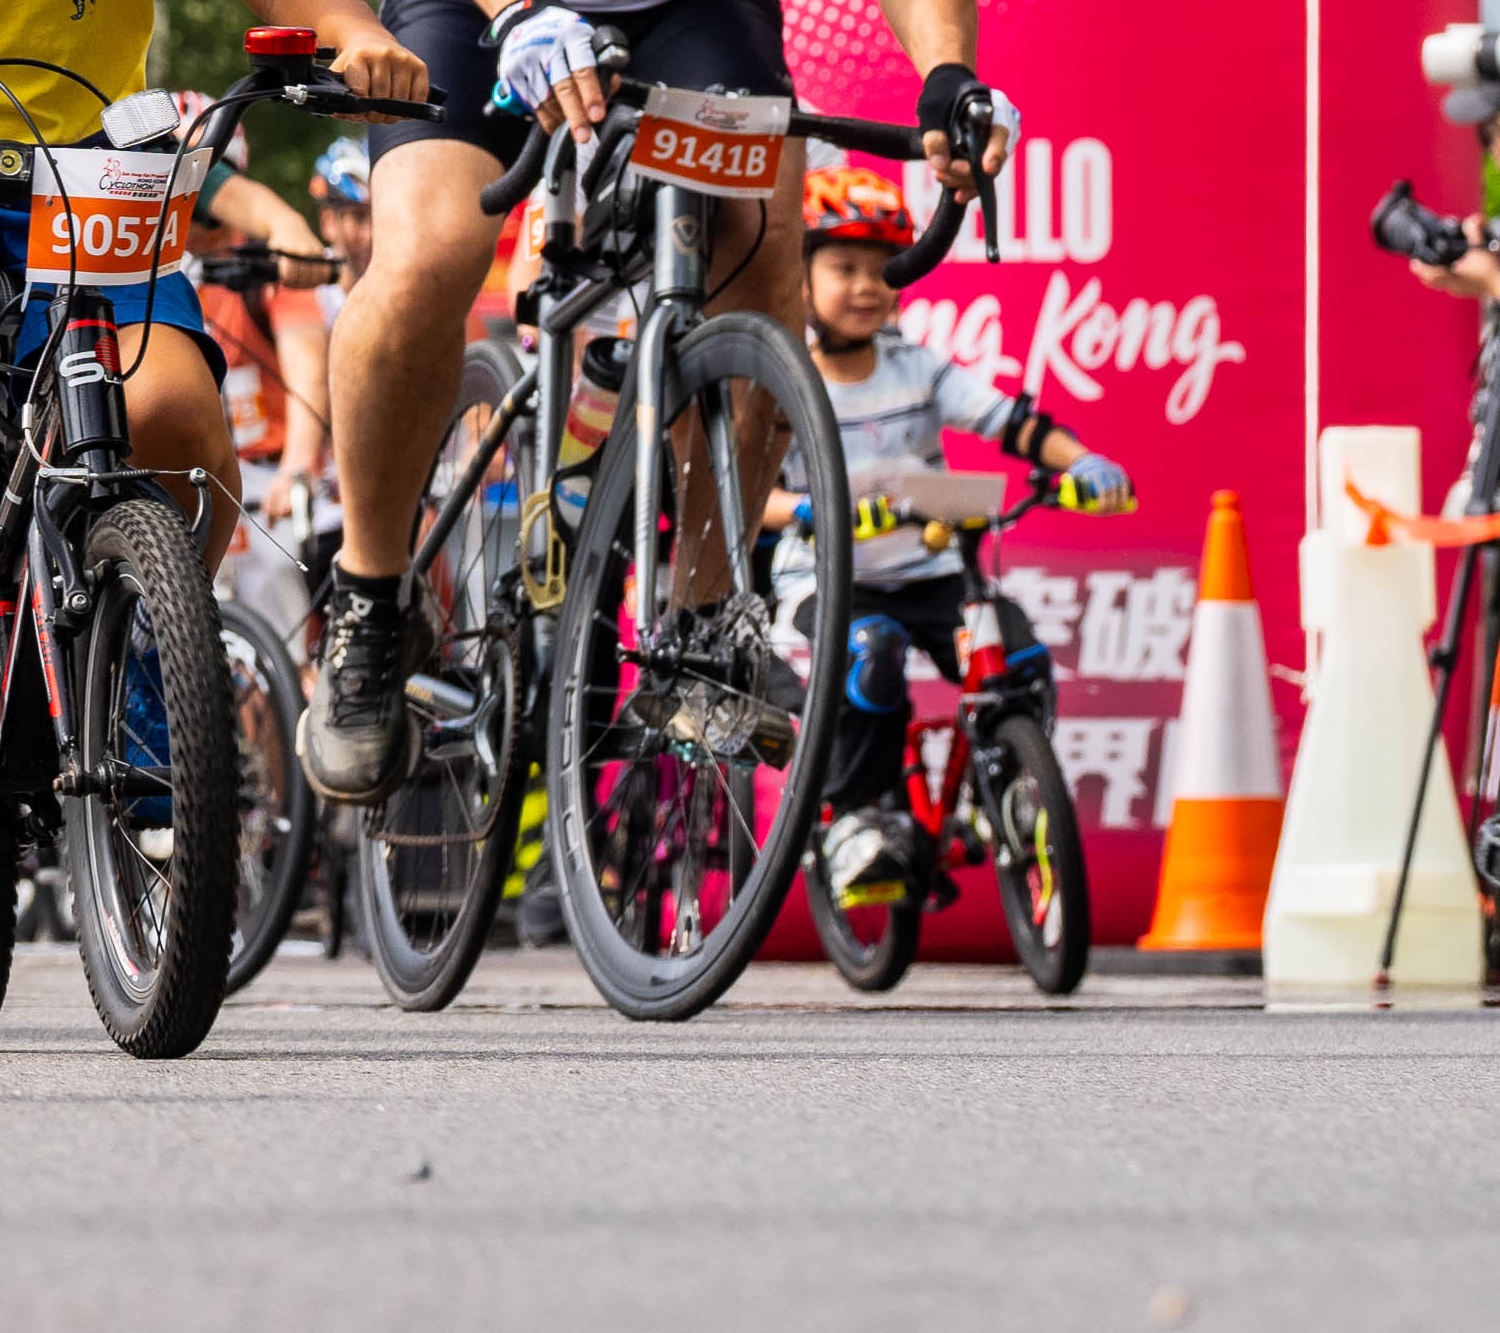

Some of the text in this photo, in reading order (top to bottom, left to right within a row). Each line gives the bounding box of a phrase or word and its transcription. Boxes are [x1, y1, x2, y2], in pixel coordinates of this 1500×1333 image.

[652, 128, 767, 177] 9141B
[51, 210, 178, 257] 9057A
[1022, 269, 1246, 426] Kong
